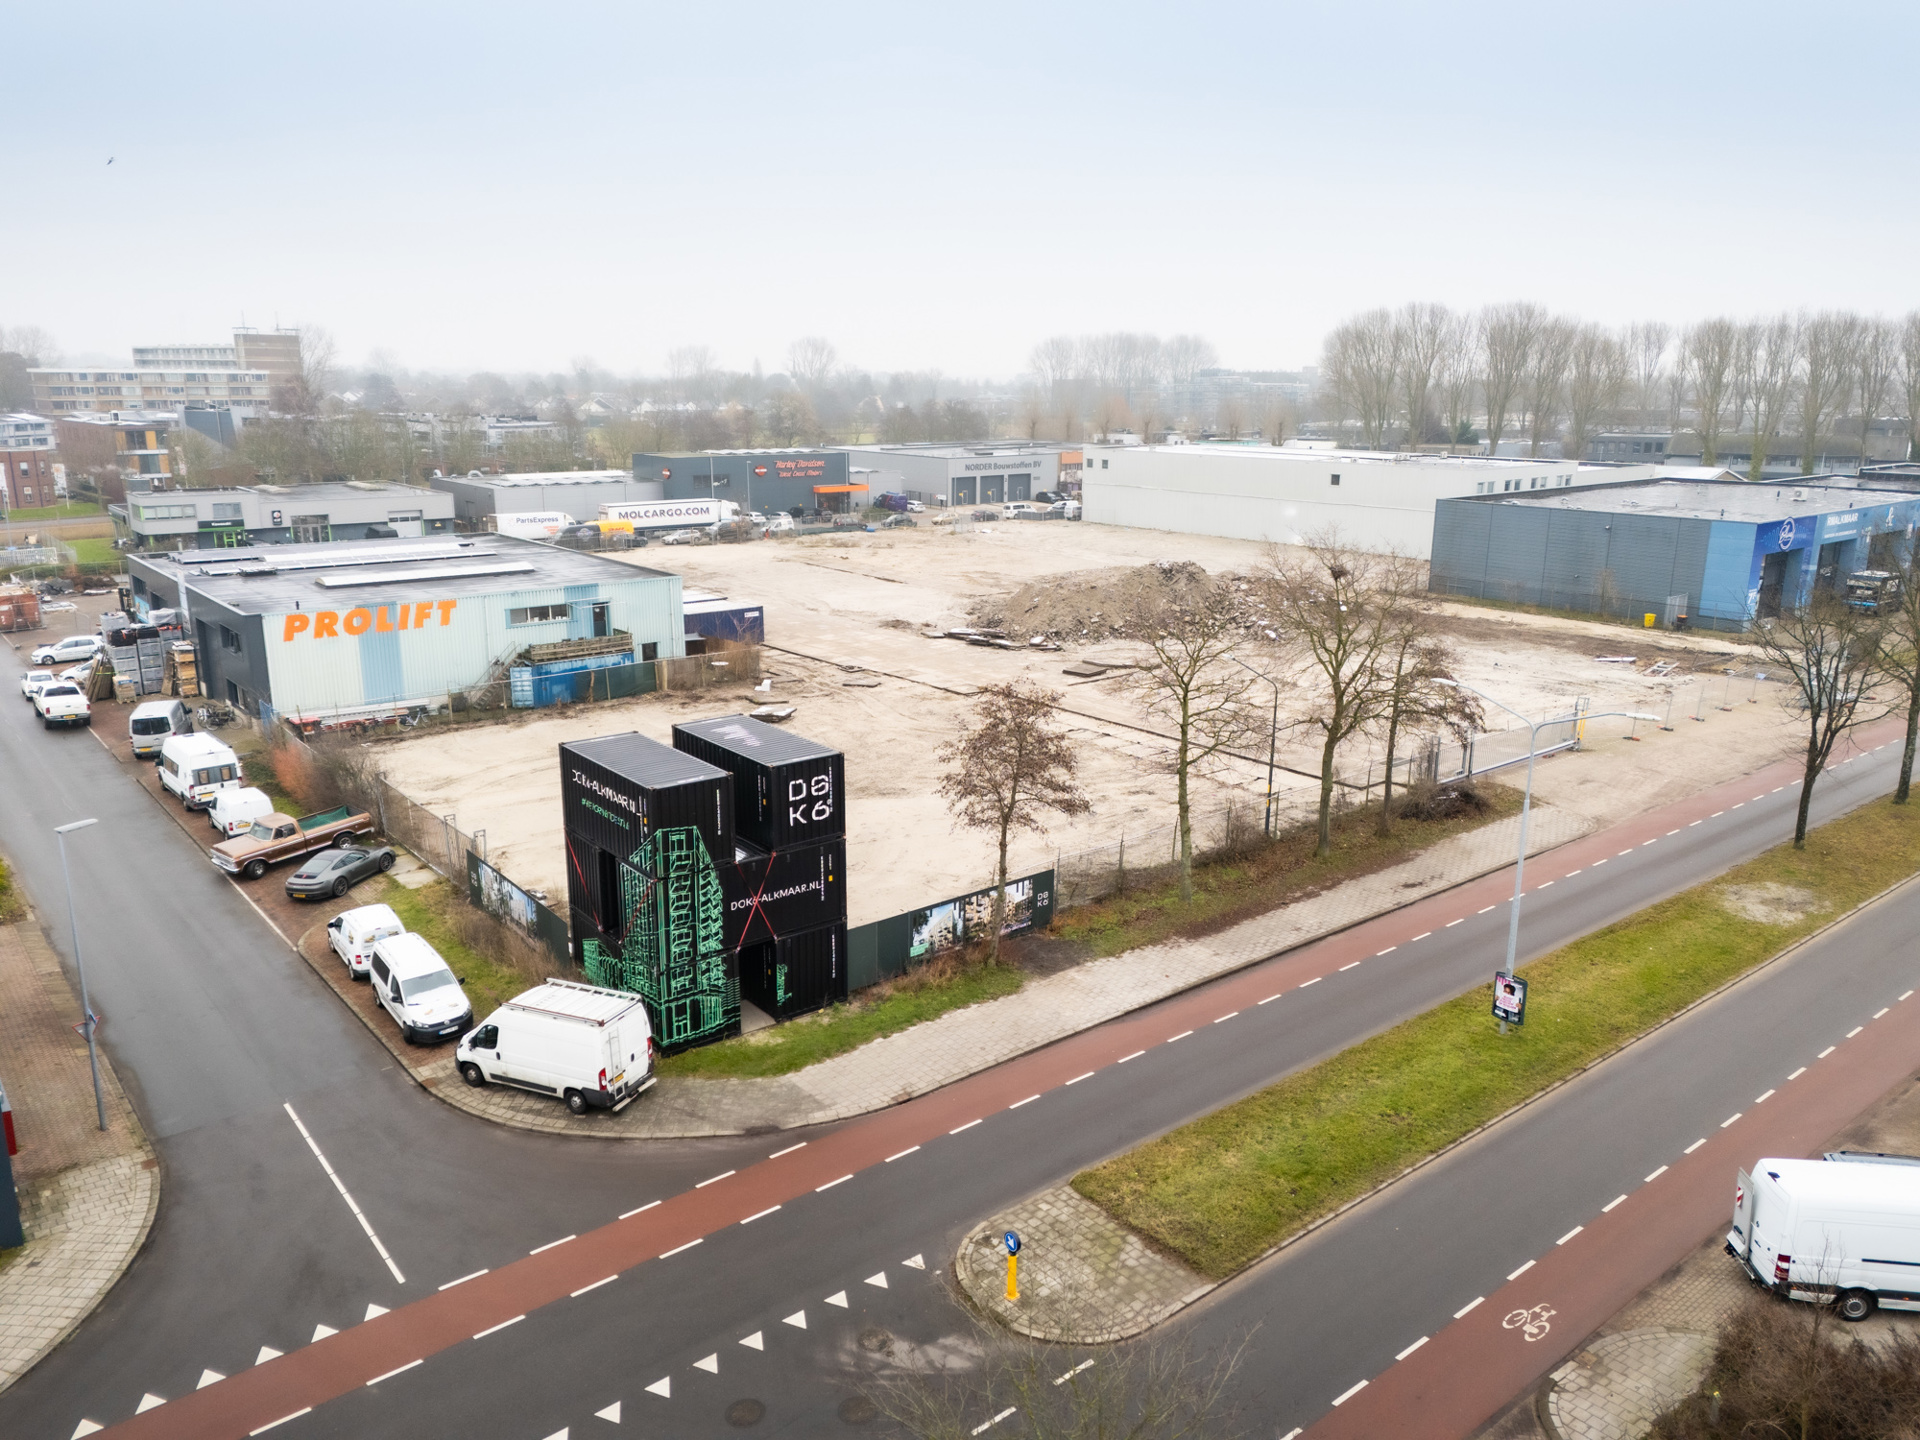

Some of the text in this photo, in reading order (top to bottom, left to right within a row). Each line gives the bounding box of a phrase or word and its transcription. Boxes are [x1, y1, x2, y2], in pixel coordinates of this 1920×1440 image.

[964, 462, 993, 471] NORDER
[993, 461, 1032, 470] Bouwstoffen
[618, 506, 710, 521] MOLCARGO.COM
[516, 516, 559, 524] PartsExpress
[283, 600, 458, 642] PROLIFT
